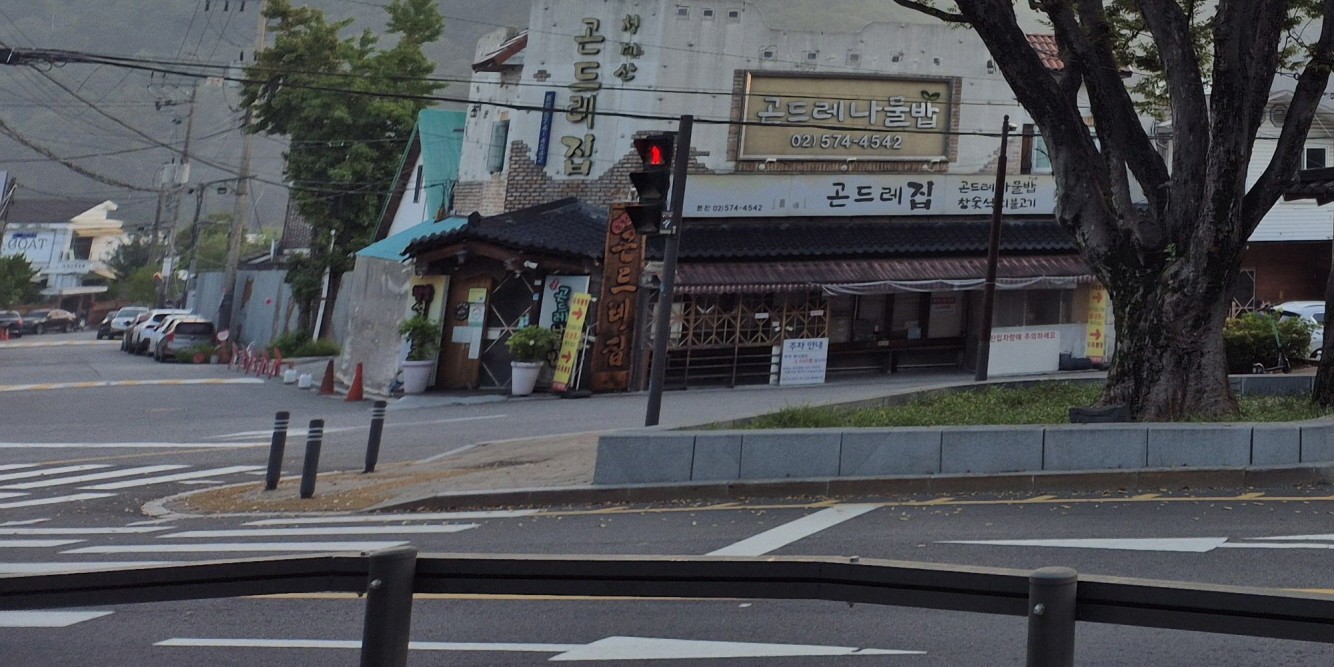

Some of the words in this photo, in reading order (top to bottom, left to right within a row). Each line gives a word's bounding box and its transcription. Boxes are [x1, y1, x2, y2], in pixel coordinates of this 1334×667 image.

[561, 17, 605, 176] 곤드레집
[757, 95, 941, 129] 곤드레나물밥
[826, 180, 935, 211] 곤드레집
[957, 196, 1037, 209] 참숯석불고기
